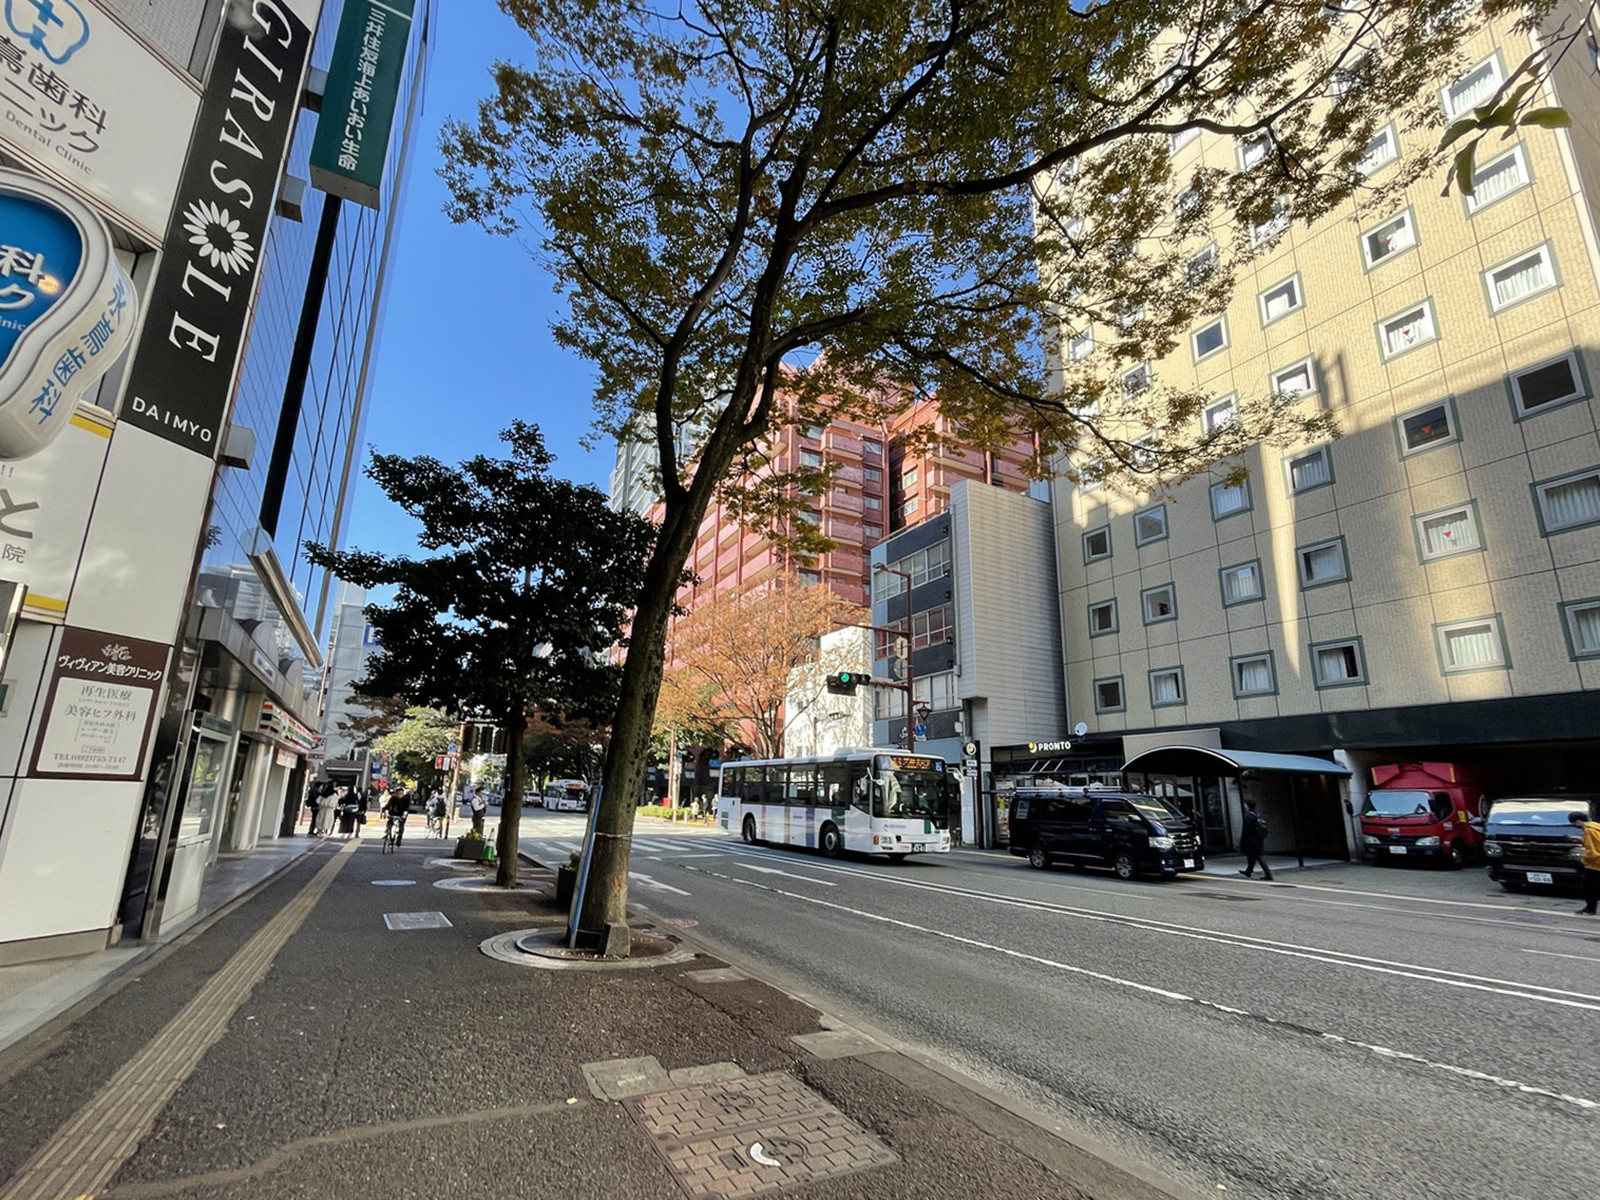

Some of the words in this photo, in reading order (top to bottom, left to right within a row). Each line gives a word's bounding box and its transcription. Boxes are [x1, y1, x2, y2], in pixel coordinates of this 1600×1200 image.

[338, 7, 387, 171] 三井住友海上あいおい生命
[5, 110, 51, 146] Dental
[55, 145, 91, 174] Clinic
[131, 396, 212, 442] DAIMYO
[2, 543, 26, 564] 院
[58, 655, 162, 681] ヴィヴィアン美容クリニック
[81, 685, 133, 701] 再生医療
[65, 704, 136, 721] 美容ヒフ外科
[1038, 741, 1071, 751] PRONTO
